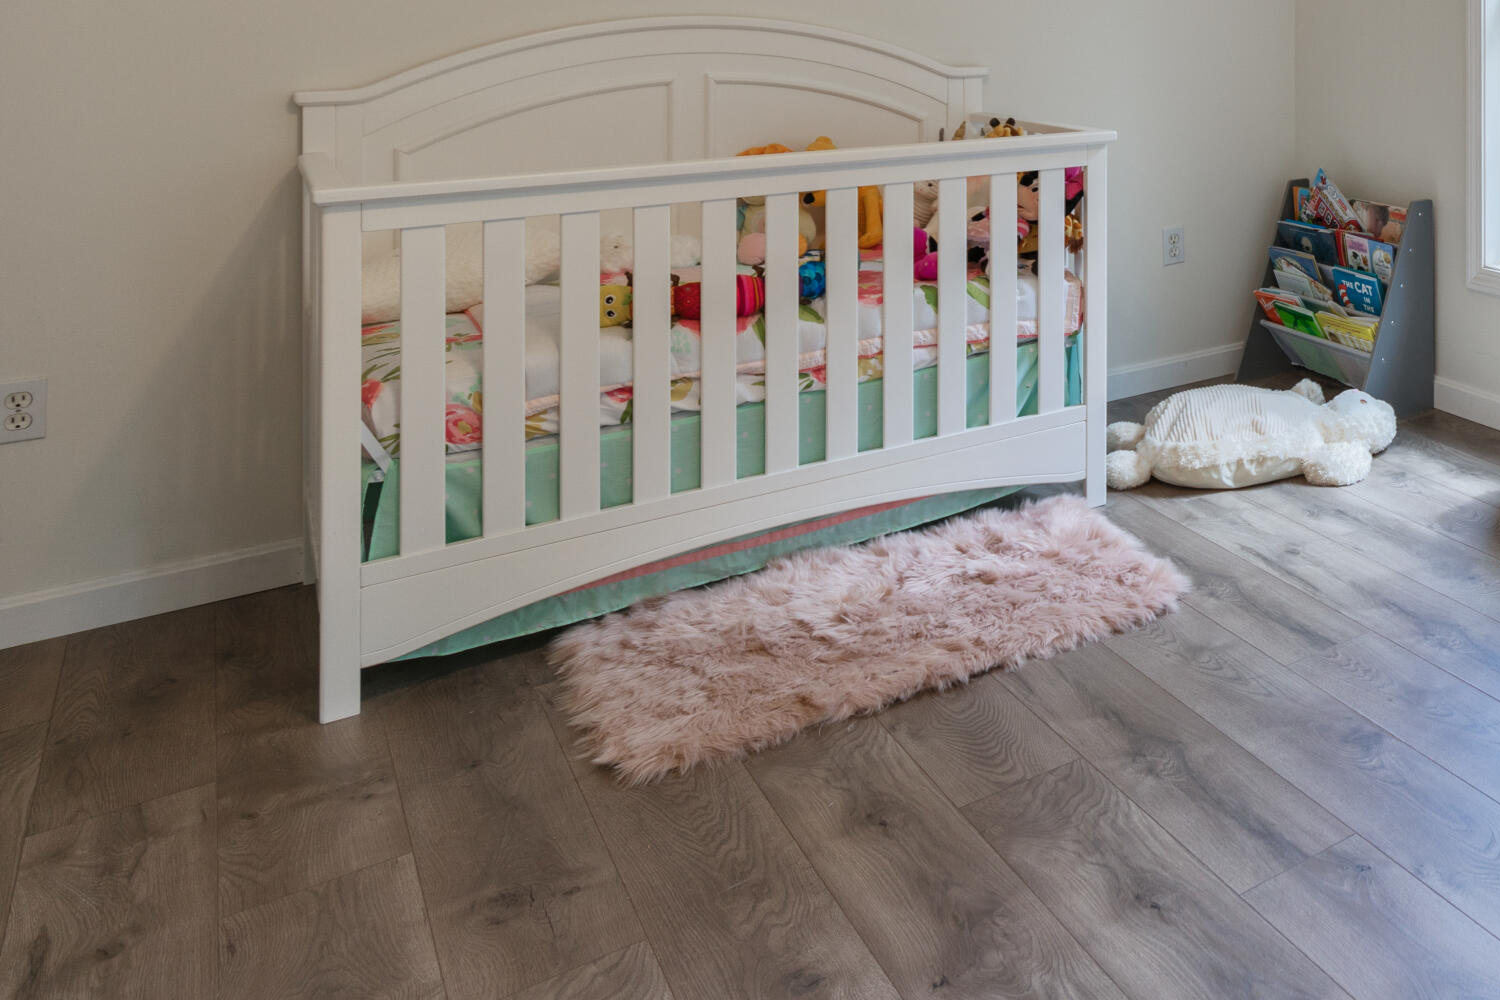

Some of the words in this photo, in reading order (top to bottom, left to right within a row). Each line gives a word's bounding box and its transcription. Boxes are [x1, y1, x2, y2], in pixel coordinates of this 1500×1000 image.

[1341, 279, 1354, 290] THE
[1354, 281, 1373, 297] CAT
[1363, 296, 1371, 305] IN
